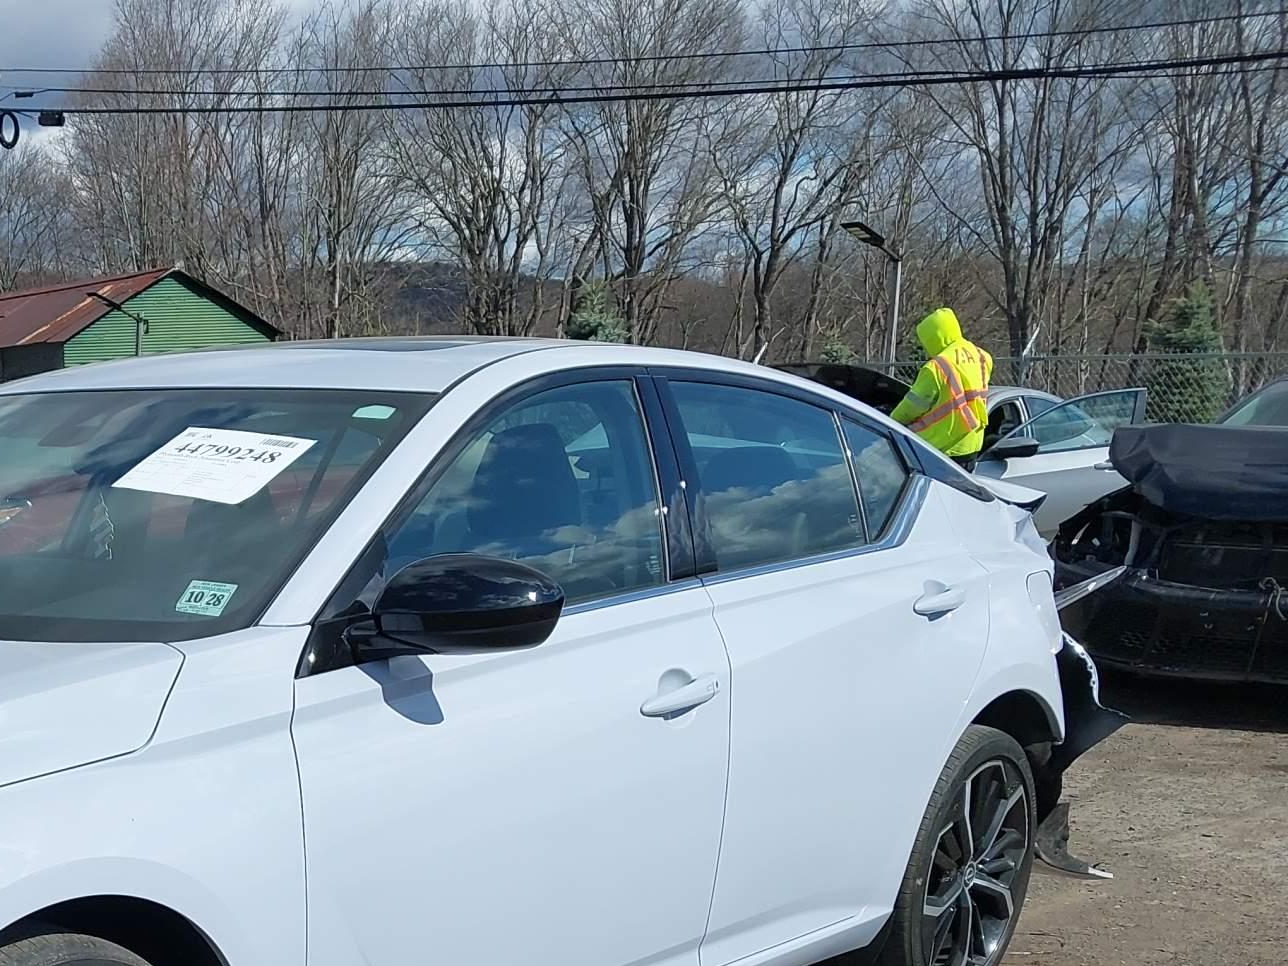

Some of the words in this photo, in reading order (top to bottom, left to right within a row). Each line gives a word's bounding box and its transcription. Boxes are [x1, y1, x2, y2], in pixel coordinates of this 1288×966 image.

[175, 442, 282, 463] 44799248
[184, 590, 205, 604] 10
[205, 592, 225, 607] 28
